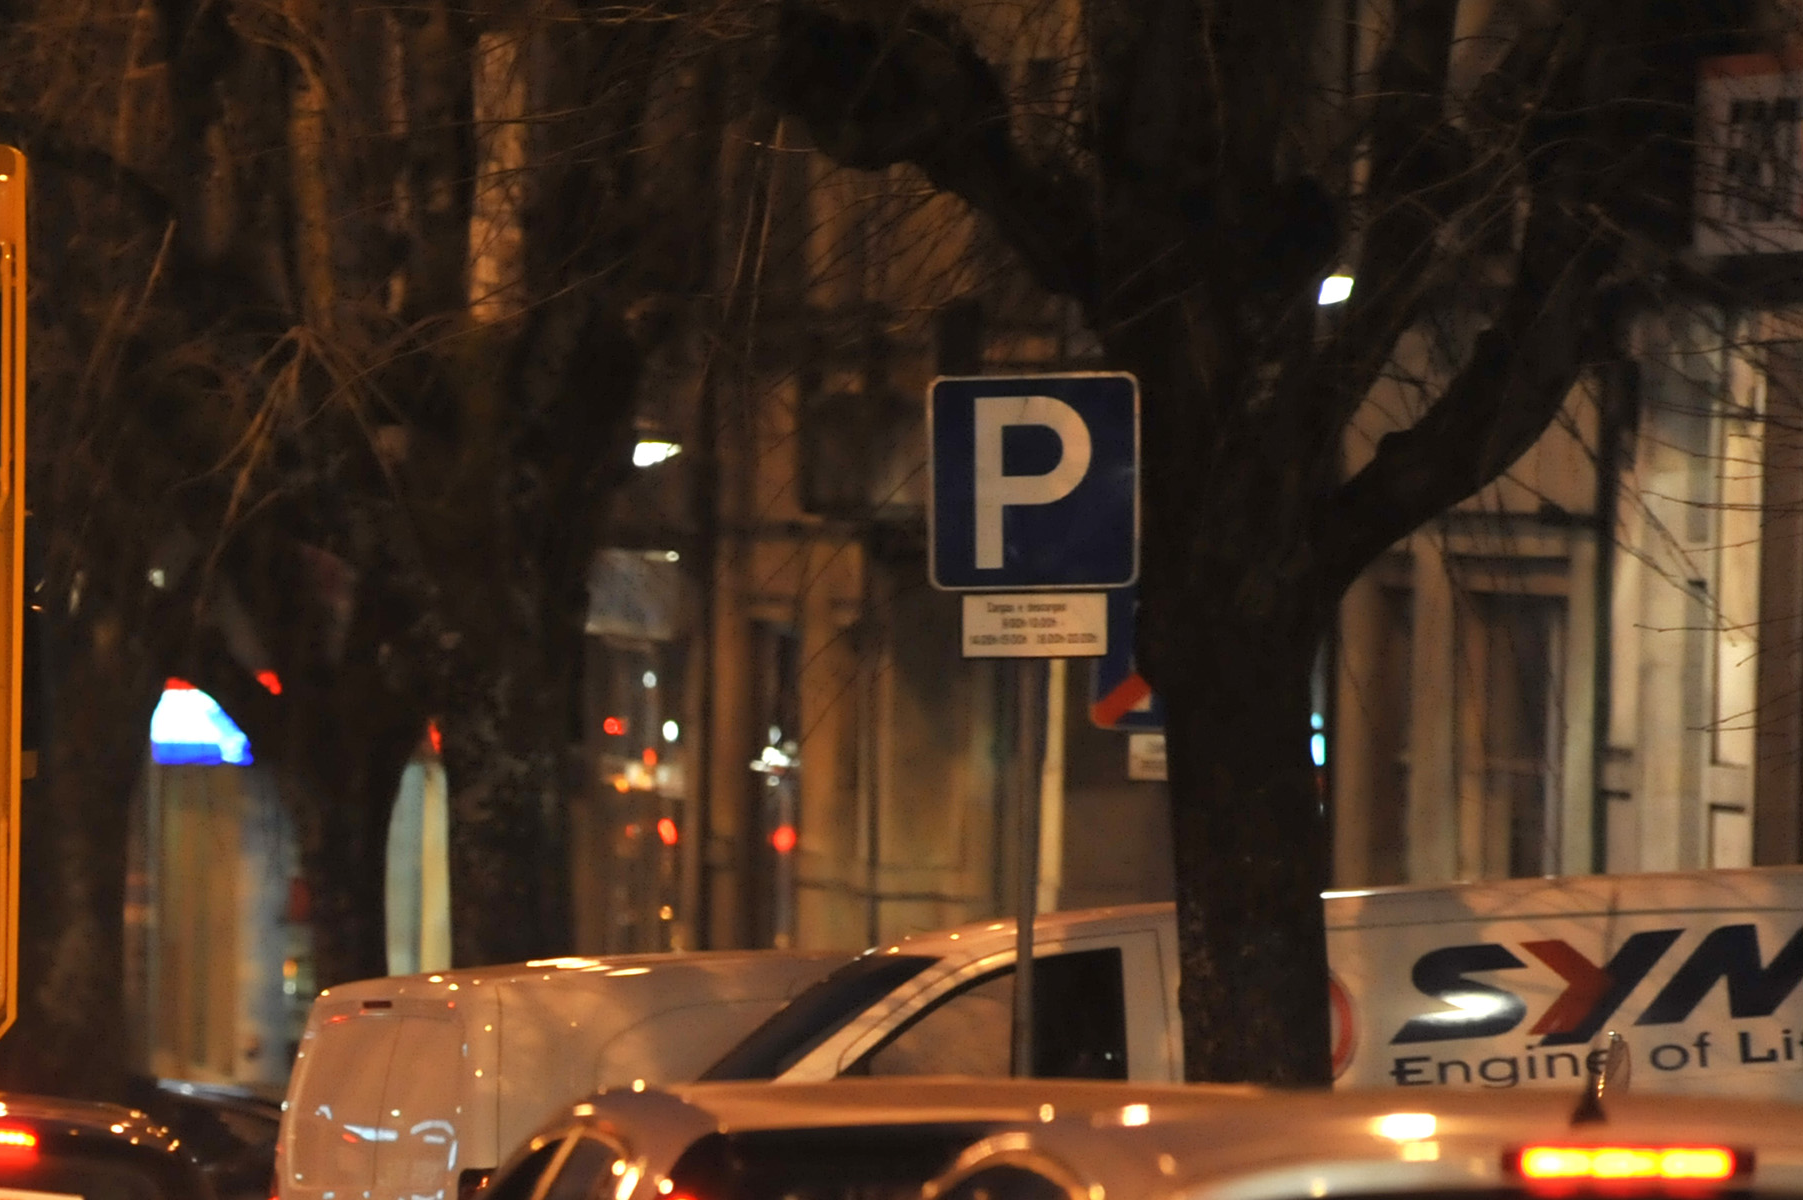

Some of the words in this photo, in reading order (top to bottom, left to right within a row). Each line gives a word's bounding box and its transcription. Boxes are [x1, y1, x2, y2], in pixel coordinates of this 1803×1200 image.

[974, 396, 1091, 569] P
[1650, 1031, 1711, 1071] of
[1739, 1029, 1803, 1064] Li
